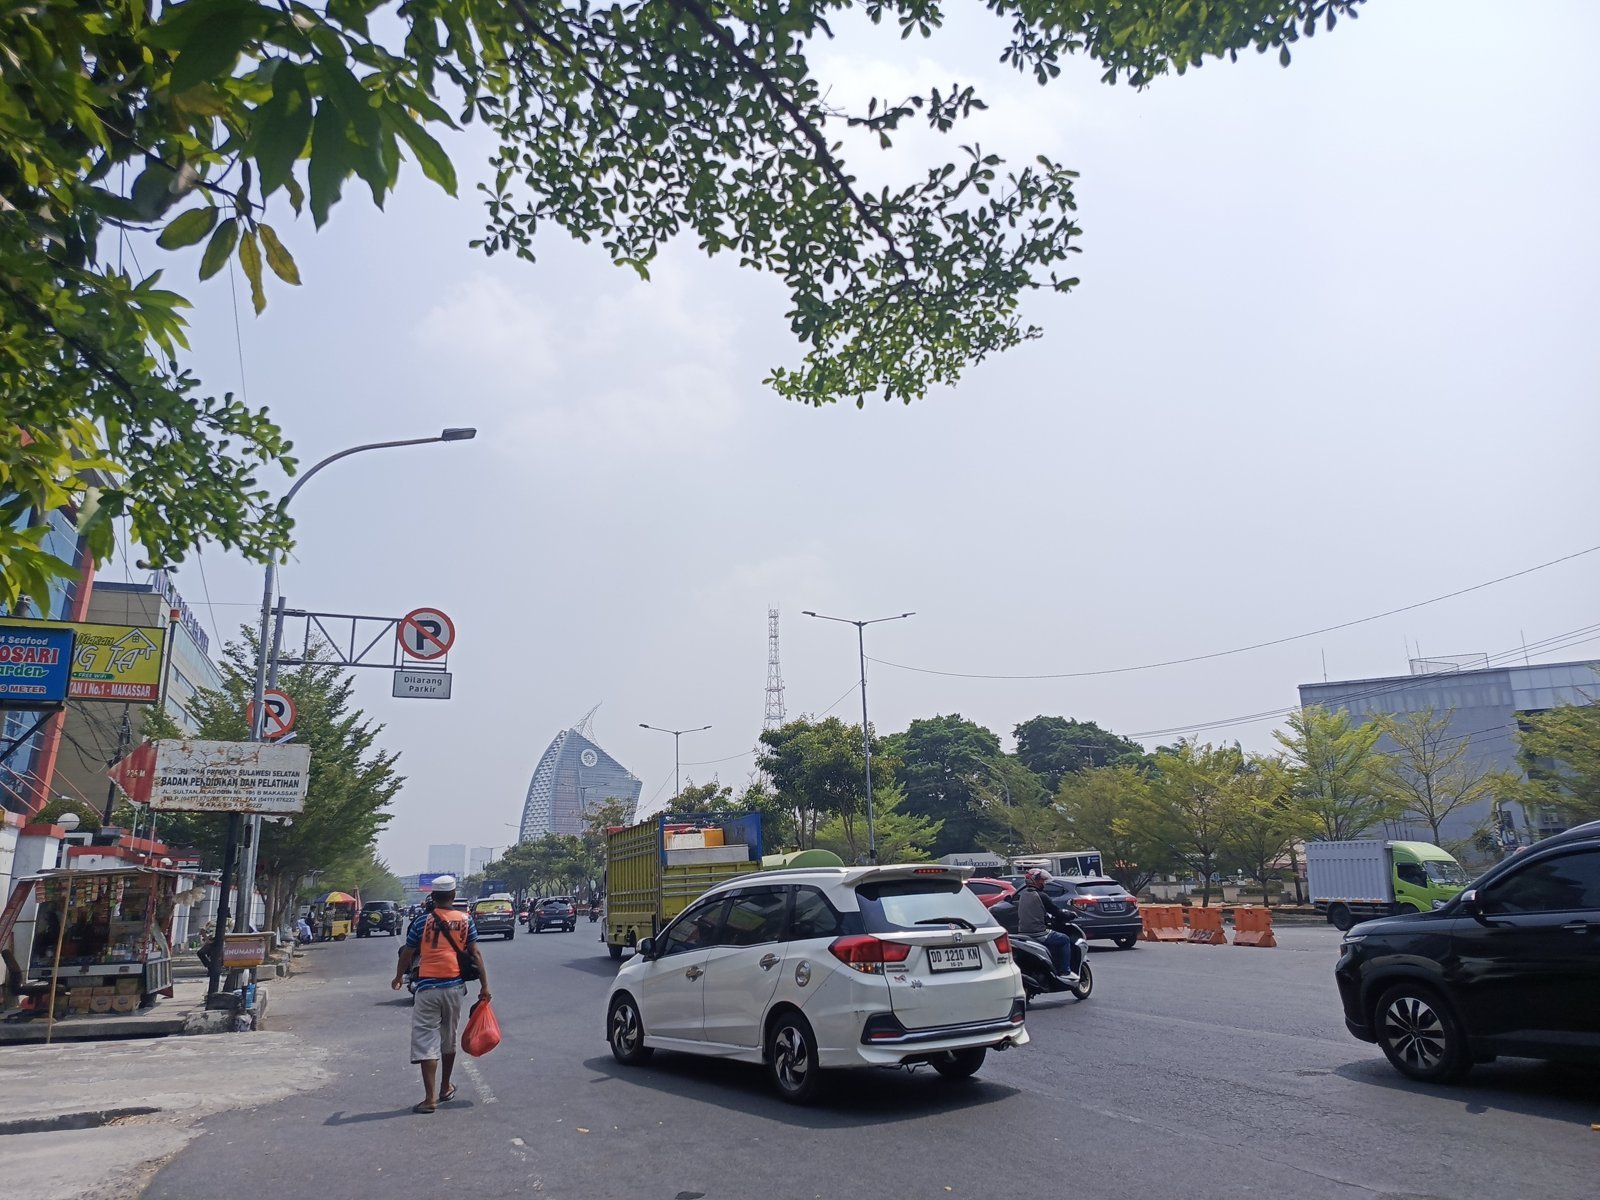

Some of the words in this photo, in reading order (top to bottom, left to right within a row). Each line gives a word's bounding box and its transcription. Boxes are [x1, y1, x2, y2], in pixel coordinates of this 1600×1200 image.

[8, 636, 49, 645] Seafood
[404, 676, 443, 686] Dilarang
[9, 685, 47, 694] METER
[111, 684, 151, 697] MAKASSAR
[409, 685, 436, 693] Parkir
[239, 769, 271, 777] SULAWESI
[161, 776, 189, 787] BADAN
[190, 777, 238, 788] PENDIDIKAN
[240, 778, 255, 788] DAN
[257, 778, 300, 789] PELATIHAN
[930, 951, 942, 963] DD
[944, 949, 965, 962] 1210
[967, 948, 978, 960] KN
